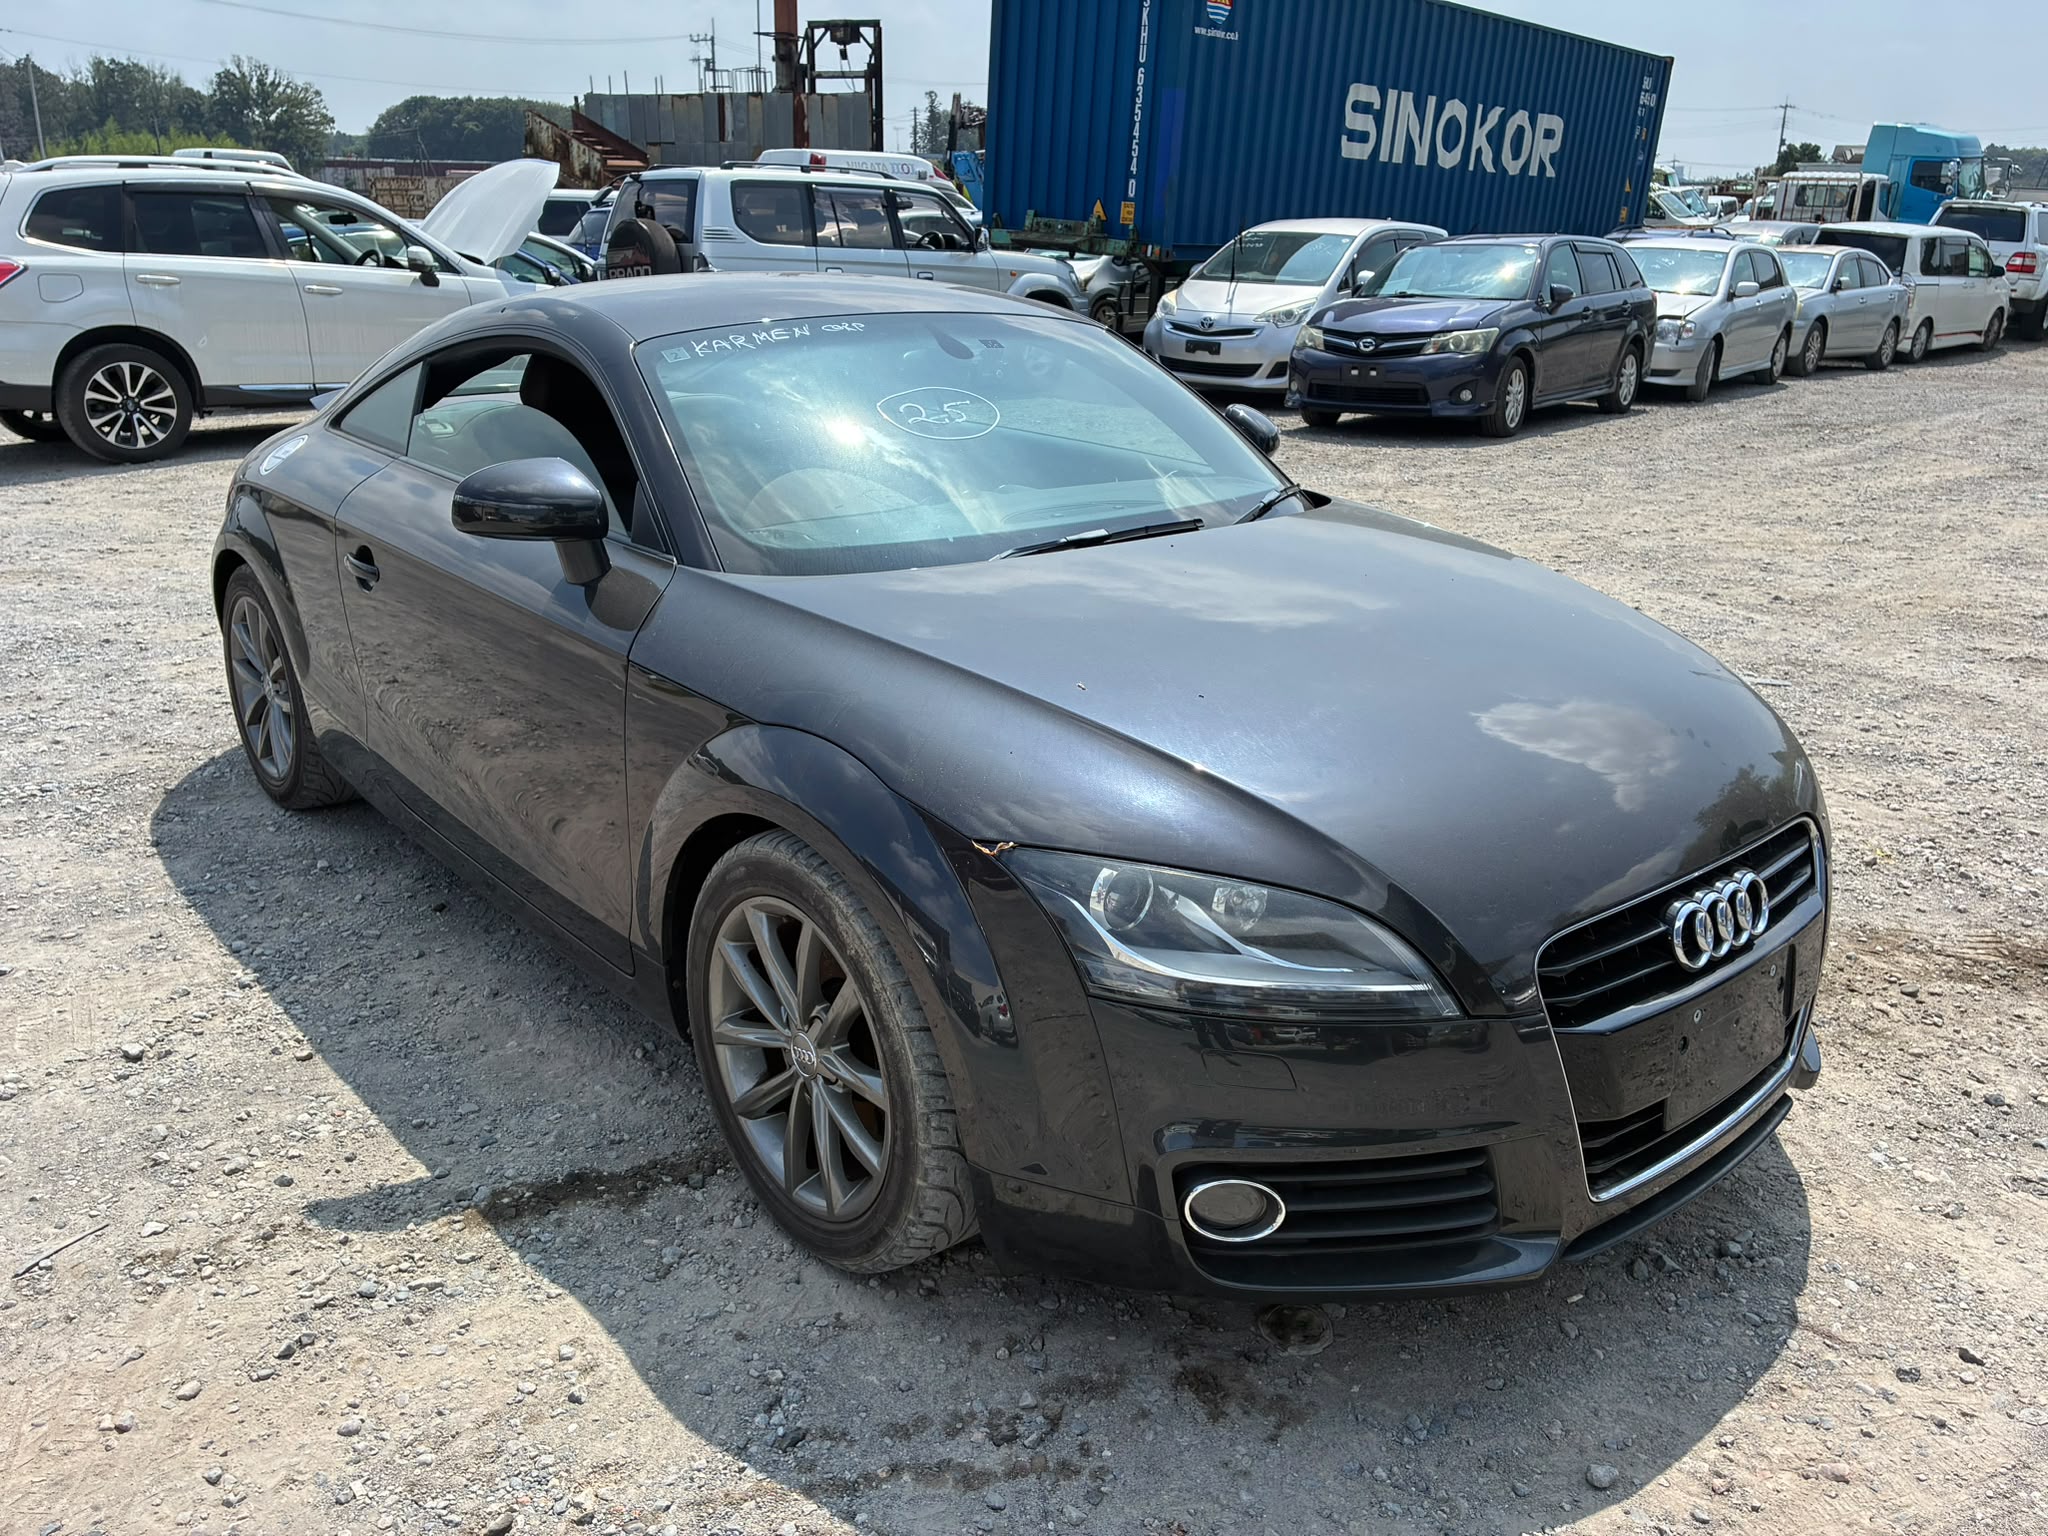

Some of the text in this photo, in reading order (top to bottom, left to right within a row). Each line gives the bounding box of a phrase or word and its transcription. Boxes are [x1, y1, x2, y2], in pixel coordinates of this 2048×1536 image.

[1130, 67, 1146, 175] 635454
[1340, 82, 1564, 178] SINOKOR
[690, 323, 811, 357] KARMEN
